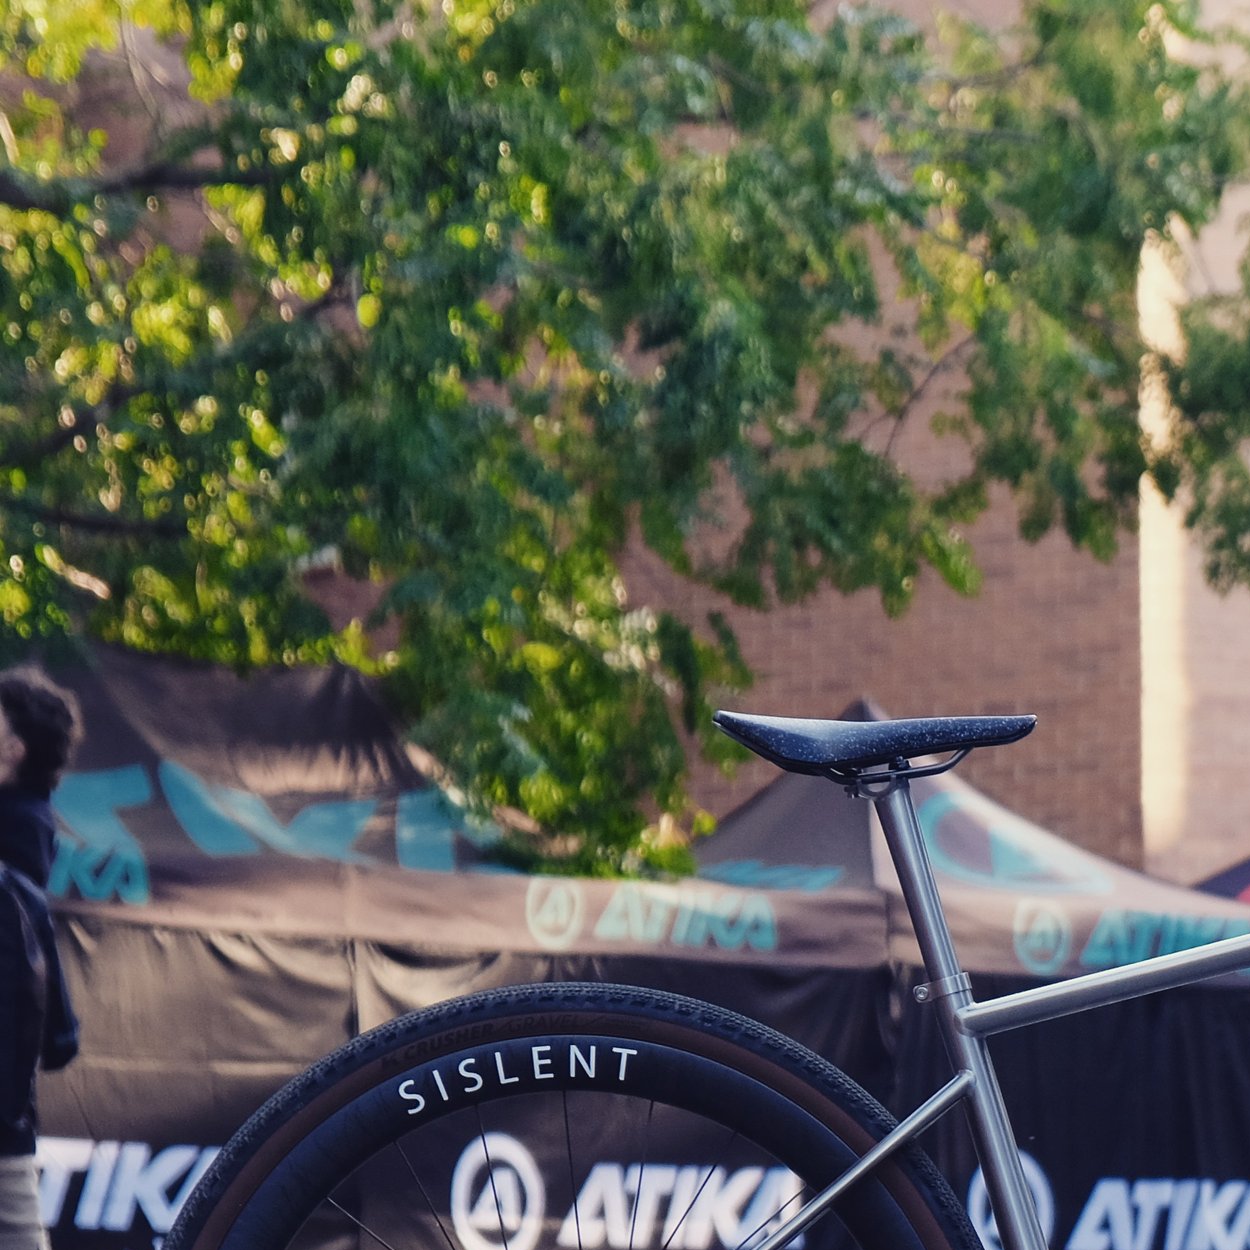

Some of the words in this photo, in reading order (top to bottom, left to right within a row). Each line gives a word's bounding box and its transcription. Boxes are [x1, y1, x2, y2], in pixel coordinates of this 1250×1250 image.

[593, 880, 779, 951] ATIKA
[398, 1045, 638, 1114] SISLENT
[35, 1135, 222, 1235] TIK
